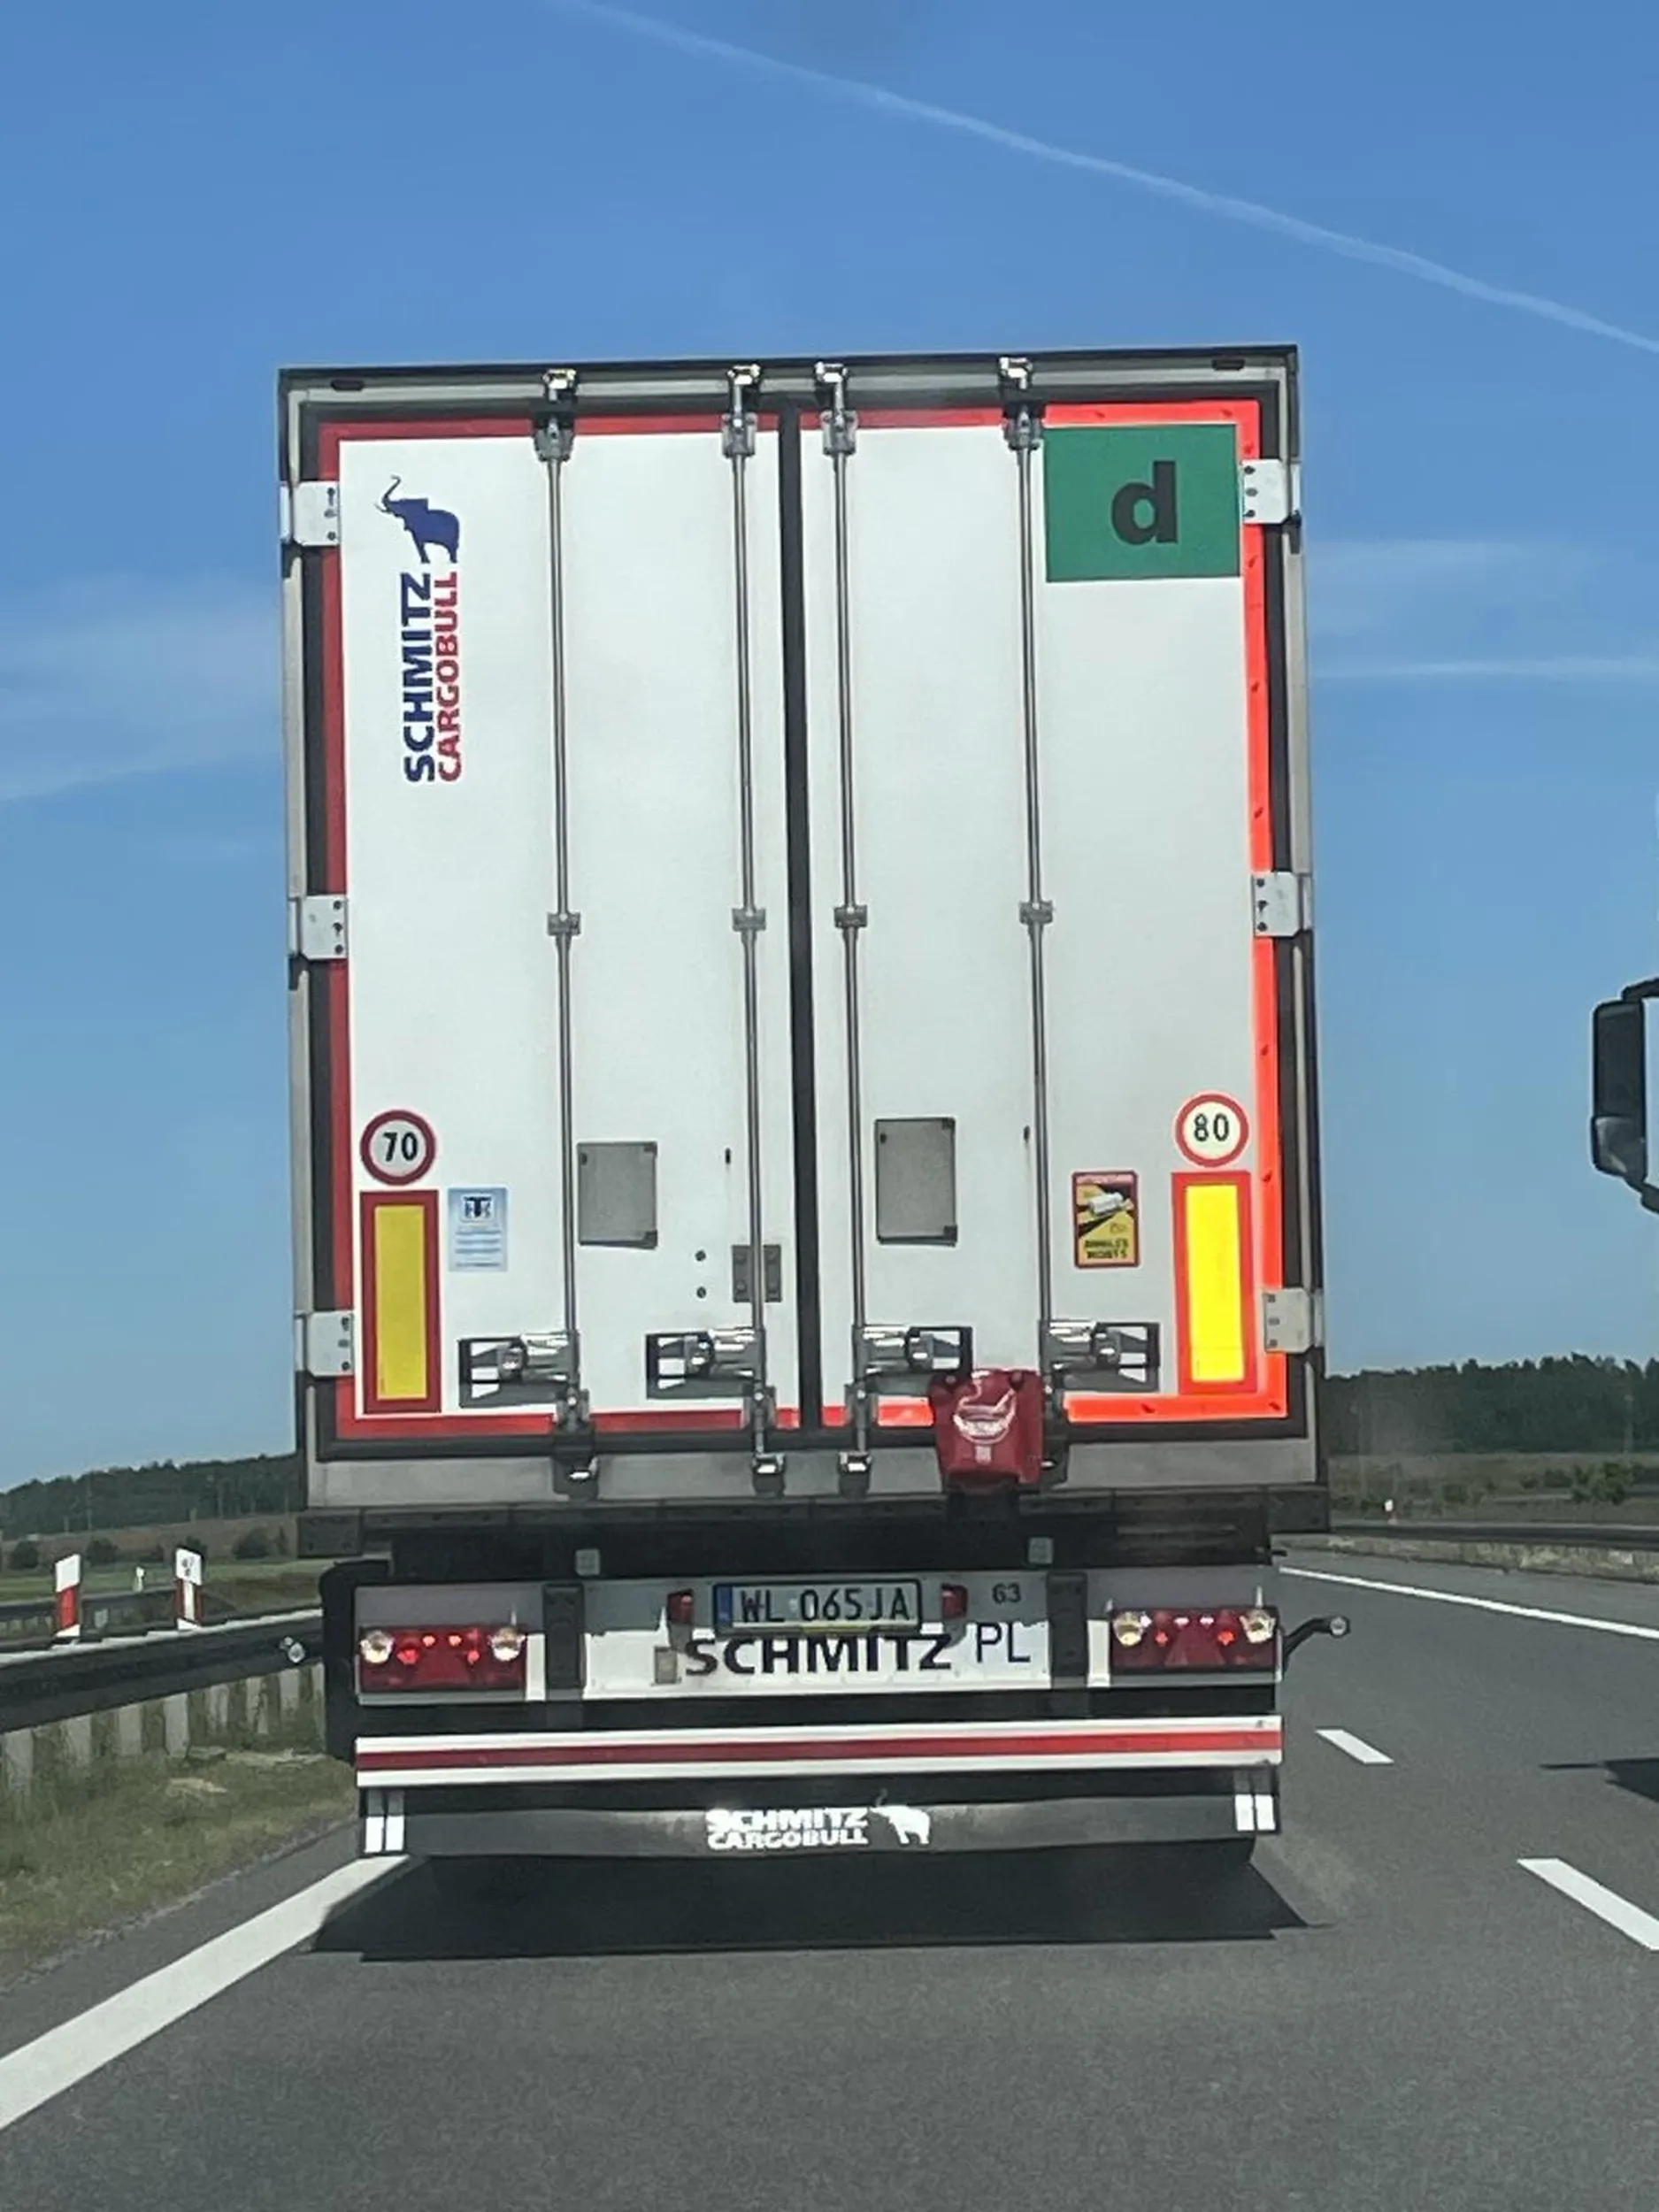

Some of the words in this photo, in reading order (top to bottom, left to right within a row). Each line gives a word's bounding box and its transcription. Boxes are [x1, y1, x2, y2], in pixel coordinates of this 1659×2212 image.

[1111, 460, 1179, 546] d
[400, 572, 434, 782] SCHMITZ
[434, 571, 462, 782] CARGOBULL
[1194, 1113, 1230, 1142] 80
[382, 1131, 419, 1163] 70
[741, 1588, 785, 1623] WL
[800, 1586, 910, 1621] 065JA
[992, 1582, 1021, 1604] 63
[685, 1633, 952, 1676] SCHMITZ
[976, 1621, 1032, 1663] PL
[705, 1806, 869, 1833] SCHMITZ
[707, 1826, 869, 1851] CARGOBULL
